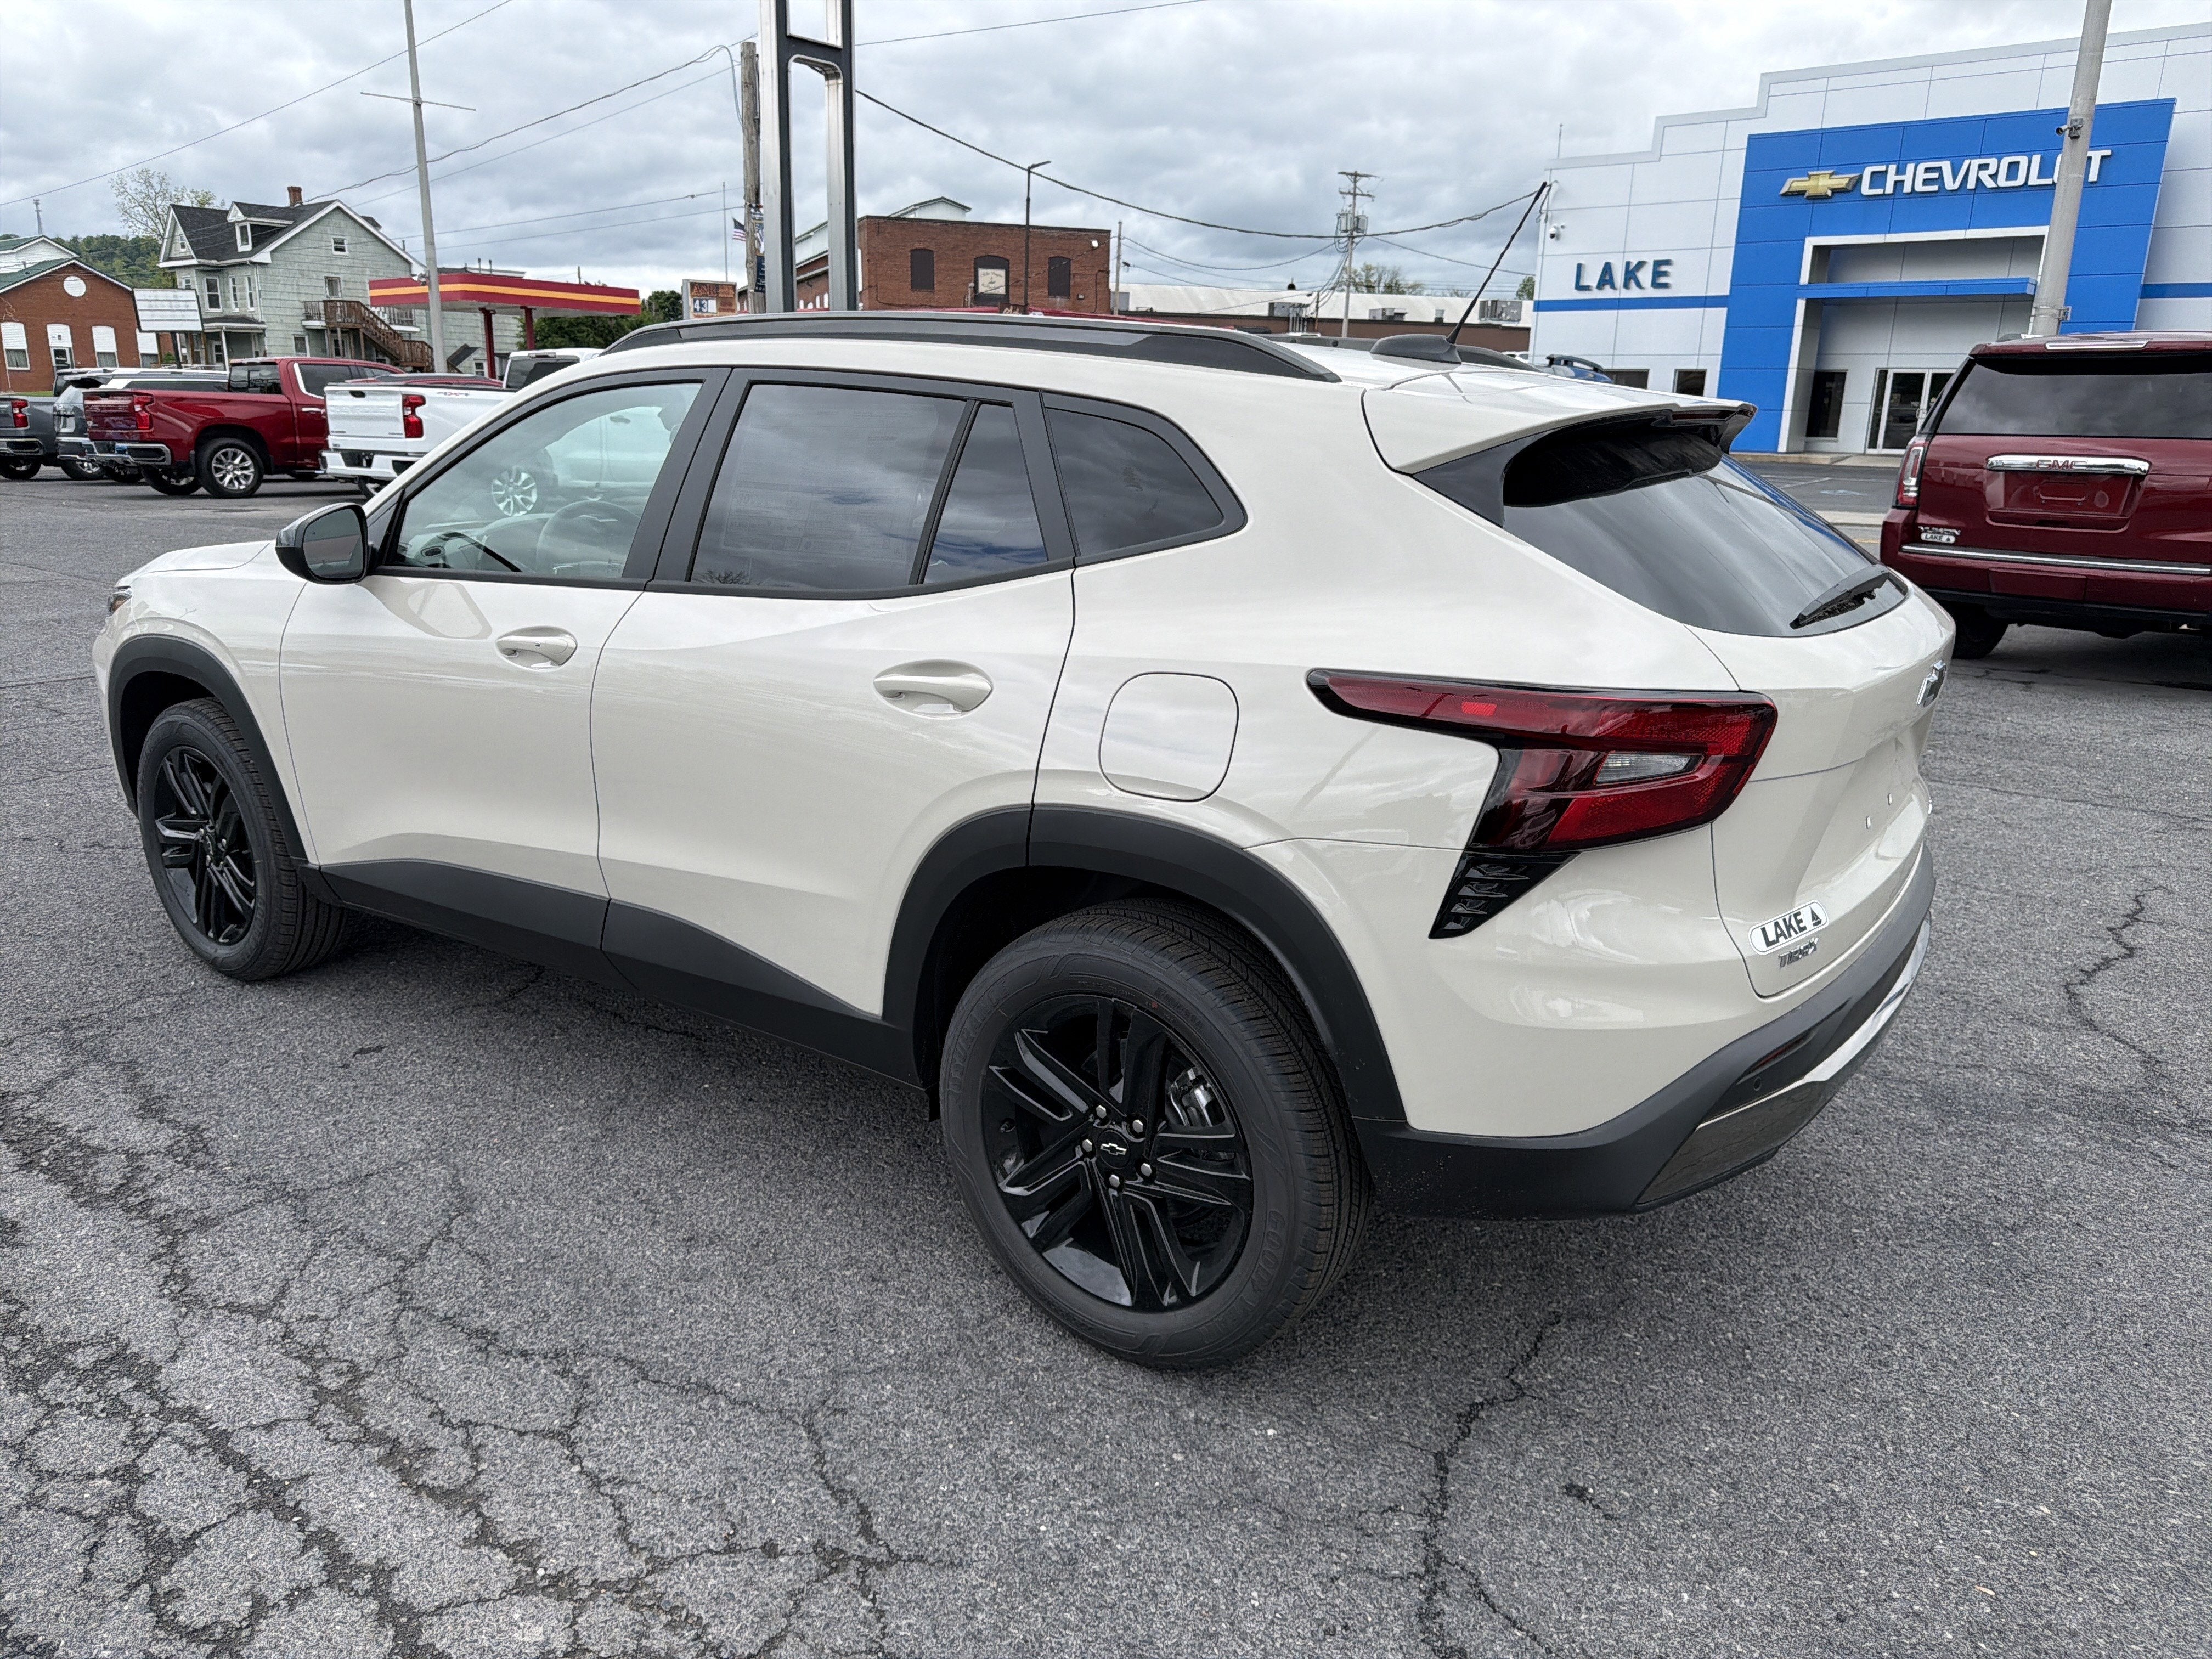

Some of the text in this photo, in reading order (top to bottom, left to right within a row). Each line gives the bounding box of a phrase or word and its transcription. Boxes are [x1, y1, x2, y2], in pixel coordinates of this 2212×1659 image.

[1575, 259, 1673, 291] LAKE
[2035, 459, 2087, 471] GMC
[1918, 526, 1961, 536] YUKON
[1925, 533, 1943, 541] LAKE
[1760, 911, 1807, 948] LAKE
